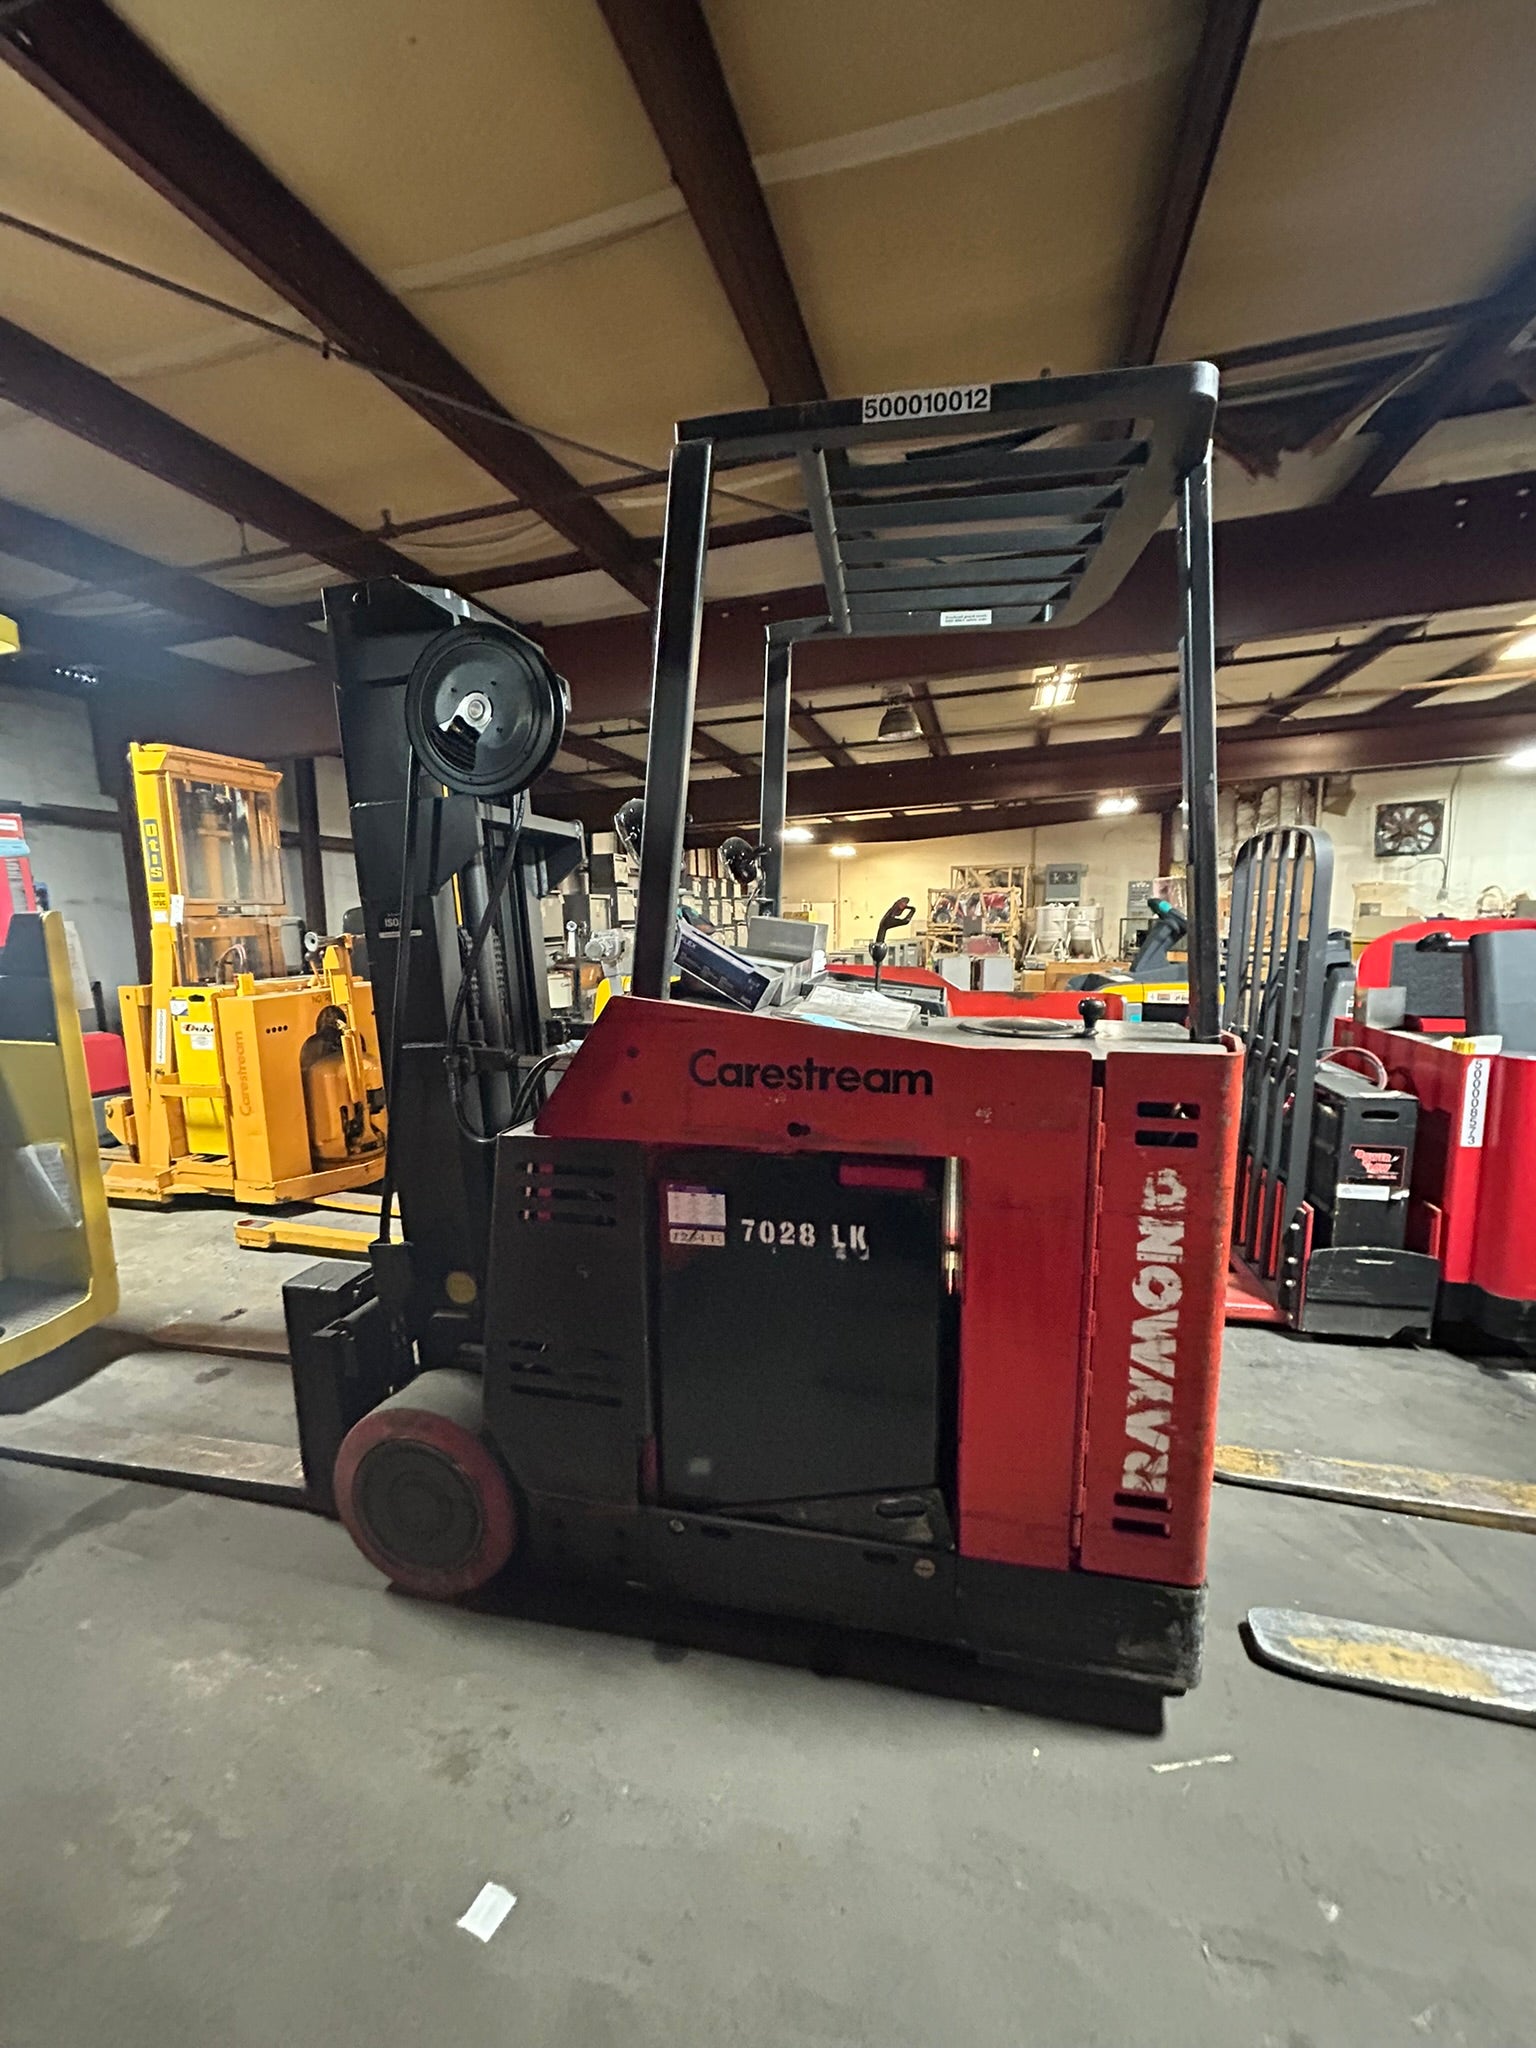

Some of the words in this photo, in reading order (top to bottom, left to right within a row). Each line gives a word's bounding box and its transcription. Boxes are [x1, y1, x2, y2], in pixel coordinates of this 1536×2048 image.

[864, 388, 988, 419] 500010012
[688, 1047, 934, 1097] Carestream
[1467, 1059, 1483, 1145] 500008573
[741, 1218, 816, 1248] 7028
[1121, 1167, 1188, 1494] RAYMOND
